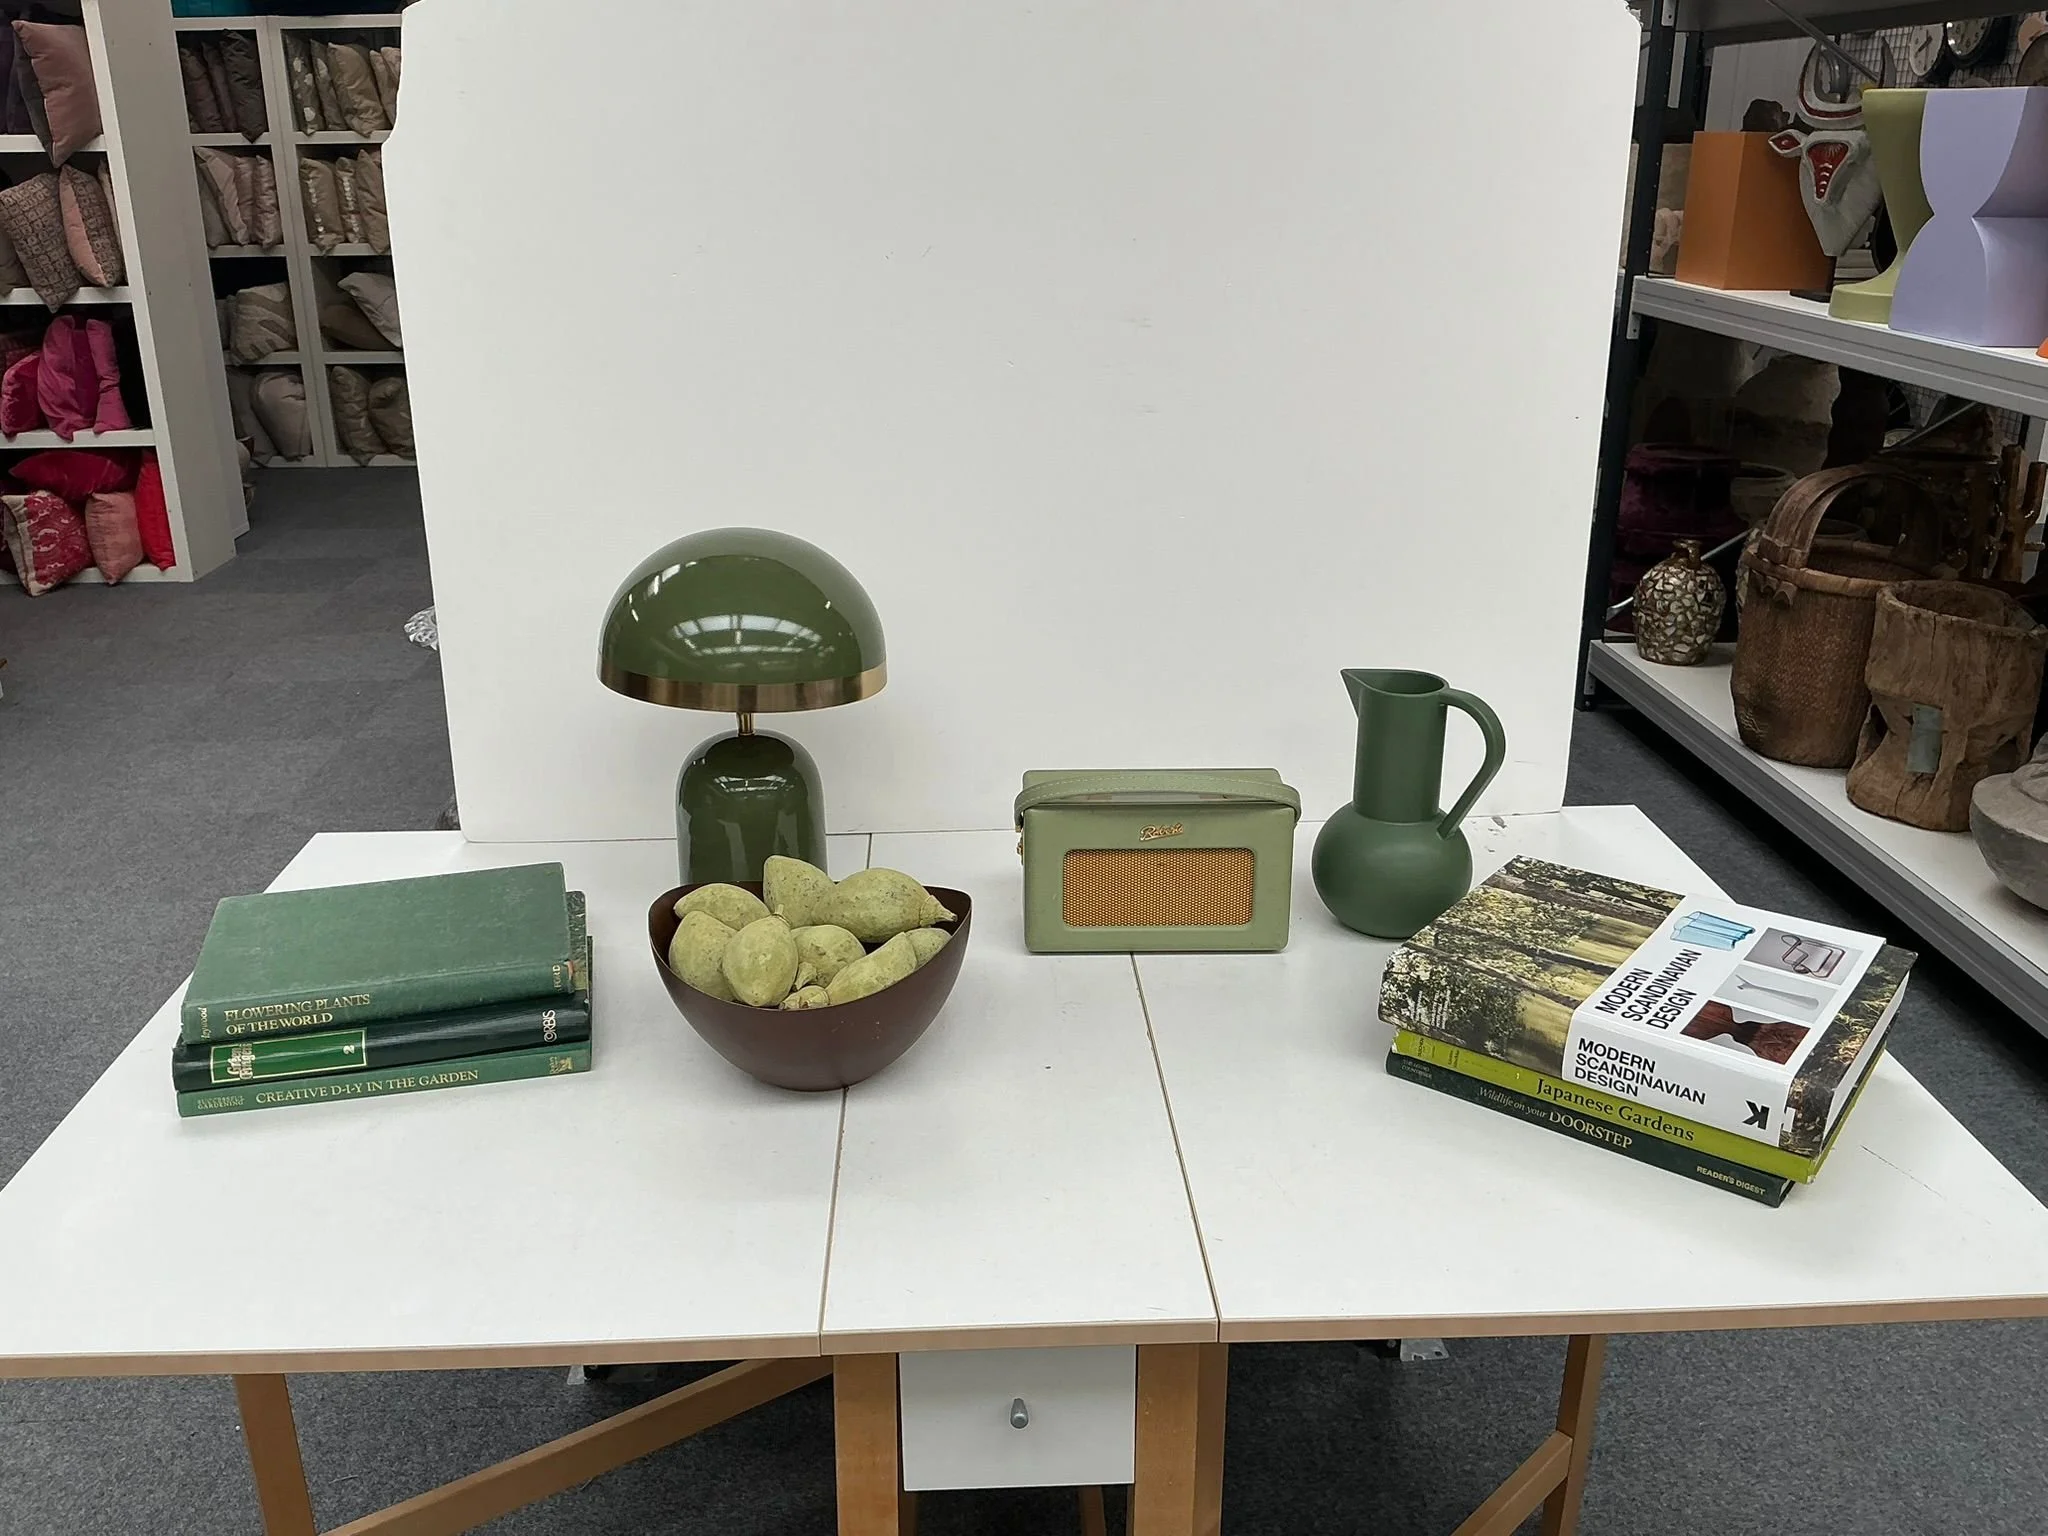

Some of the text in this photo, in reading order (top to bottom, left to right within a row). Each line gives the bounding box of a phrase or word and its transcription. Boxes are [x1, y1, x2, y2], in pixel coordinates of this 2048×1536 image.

[1595, 968, 1653, 1014] MODERN
[1621, 949, 1702, 1021] SCANDINAVIAN
[224, 994, 370, 1022] FLOWERING PLANTS
[225, 1012, 333, 1035] OF THE WORLD
[543, 1009, 557, 1042] ORBIS
[1646, 989, 1697, 1029] DESIGN
[1578, 1038, 1656, 1074] MODERN
[255, 1070, 479, 1104] CREATIVE D-I-Y IN THE GARDEN
[1574, 1067, 1639, 1098] DESIGN
[1576, 1053, 1706, 1105] SCANDINAVIAN
[1478, 1086, 1633, 1149] Wildlife on your DOORSTEP
[1537, 1078, 1695, 1141] Japanese Gardens
[1696, 1165, 1766, 1196] READER'S DIGEST
